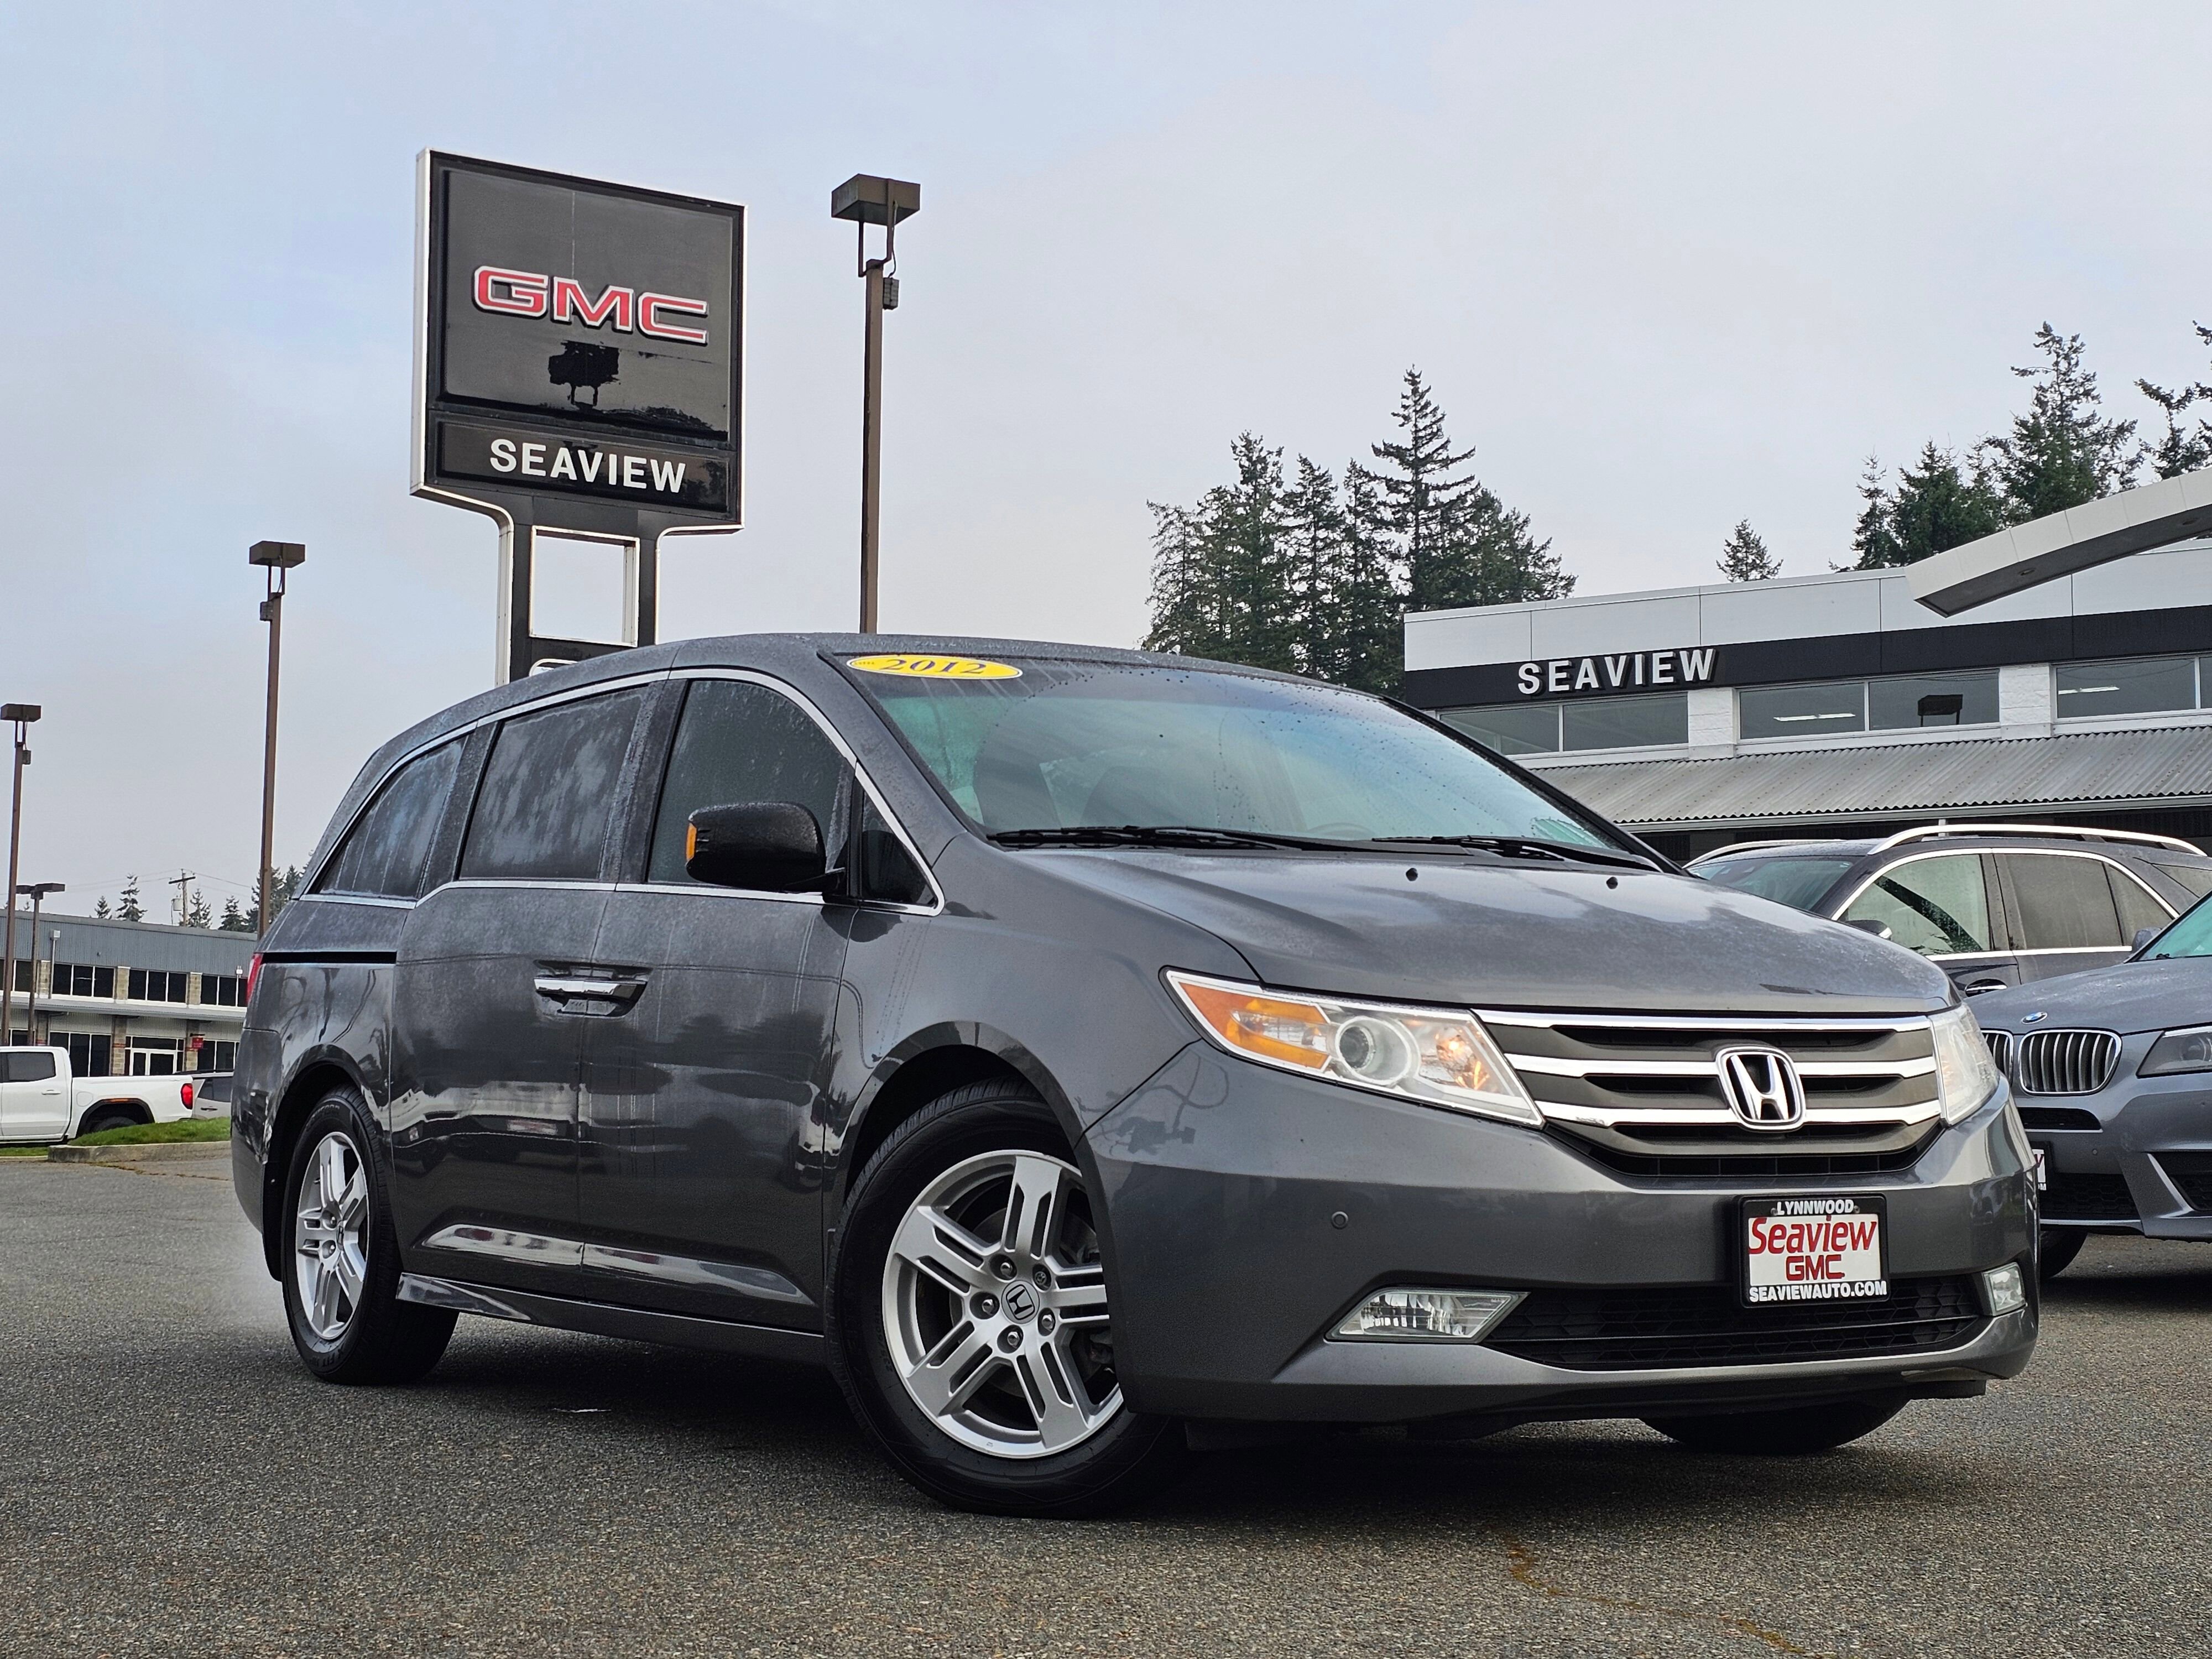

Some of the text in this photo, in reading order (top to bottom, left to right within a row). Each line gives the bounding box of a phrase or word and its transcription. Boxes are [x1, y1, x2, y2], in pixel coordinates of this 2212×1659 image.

[474, 265, 708, 343] GMC
[490, 439, 686, 493] SEAVIEW
[880, 659, 987, 674] 2012
[1518, 648, 1715, 695] SEAVIEW
[1776, 1199, 1854, 1215] LYNNWOOD
[1748, 1214, 1877, 1254] Seaview
[1786, 1254, 1845, 1281] GMC
[1749, 1281, 1887, 1302] SEAVIEWAUTO.COM
